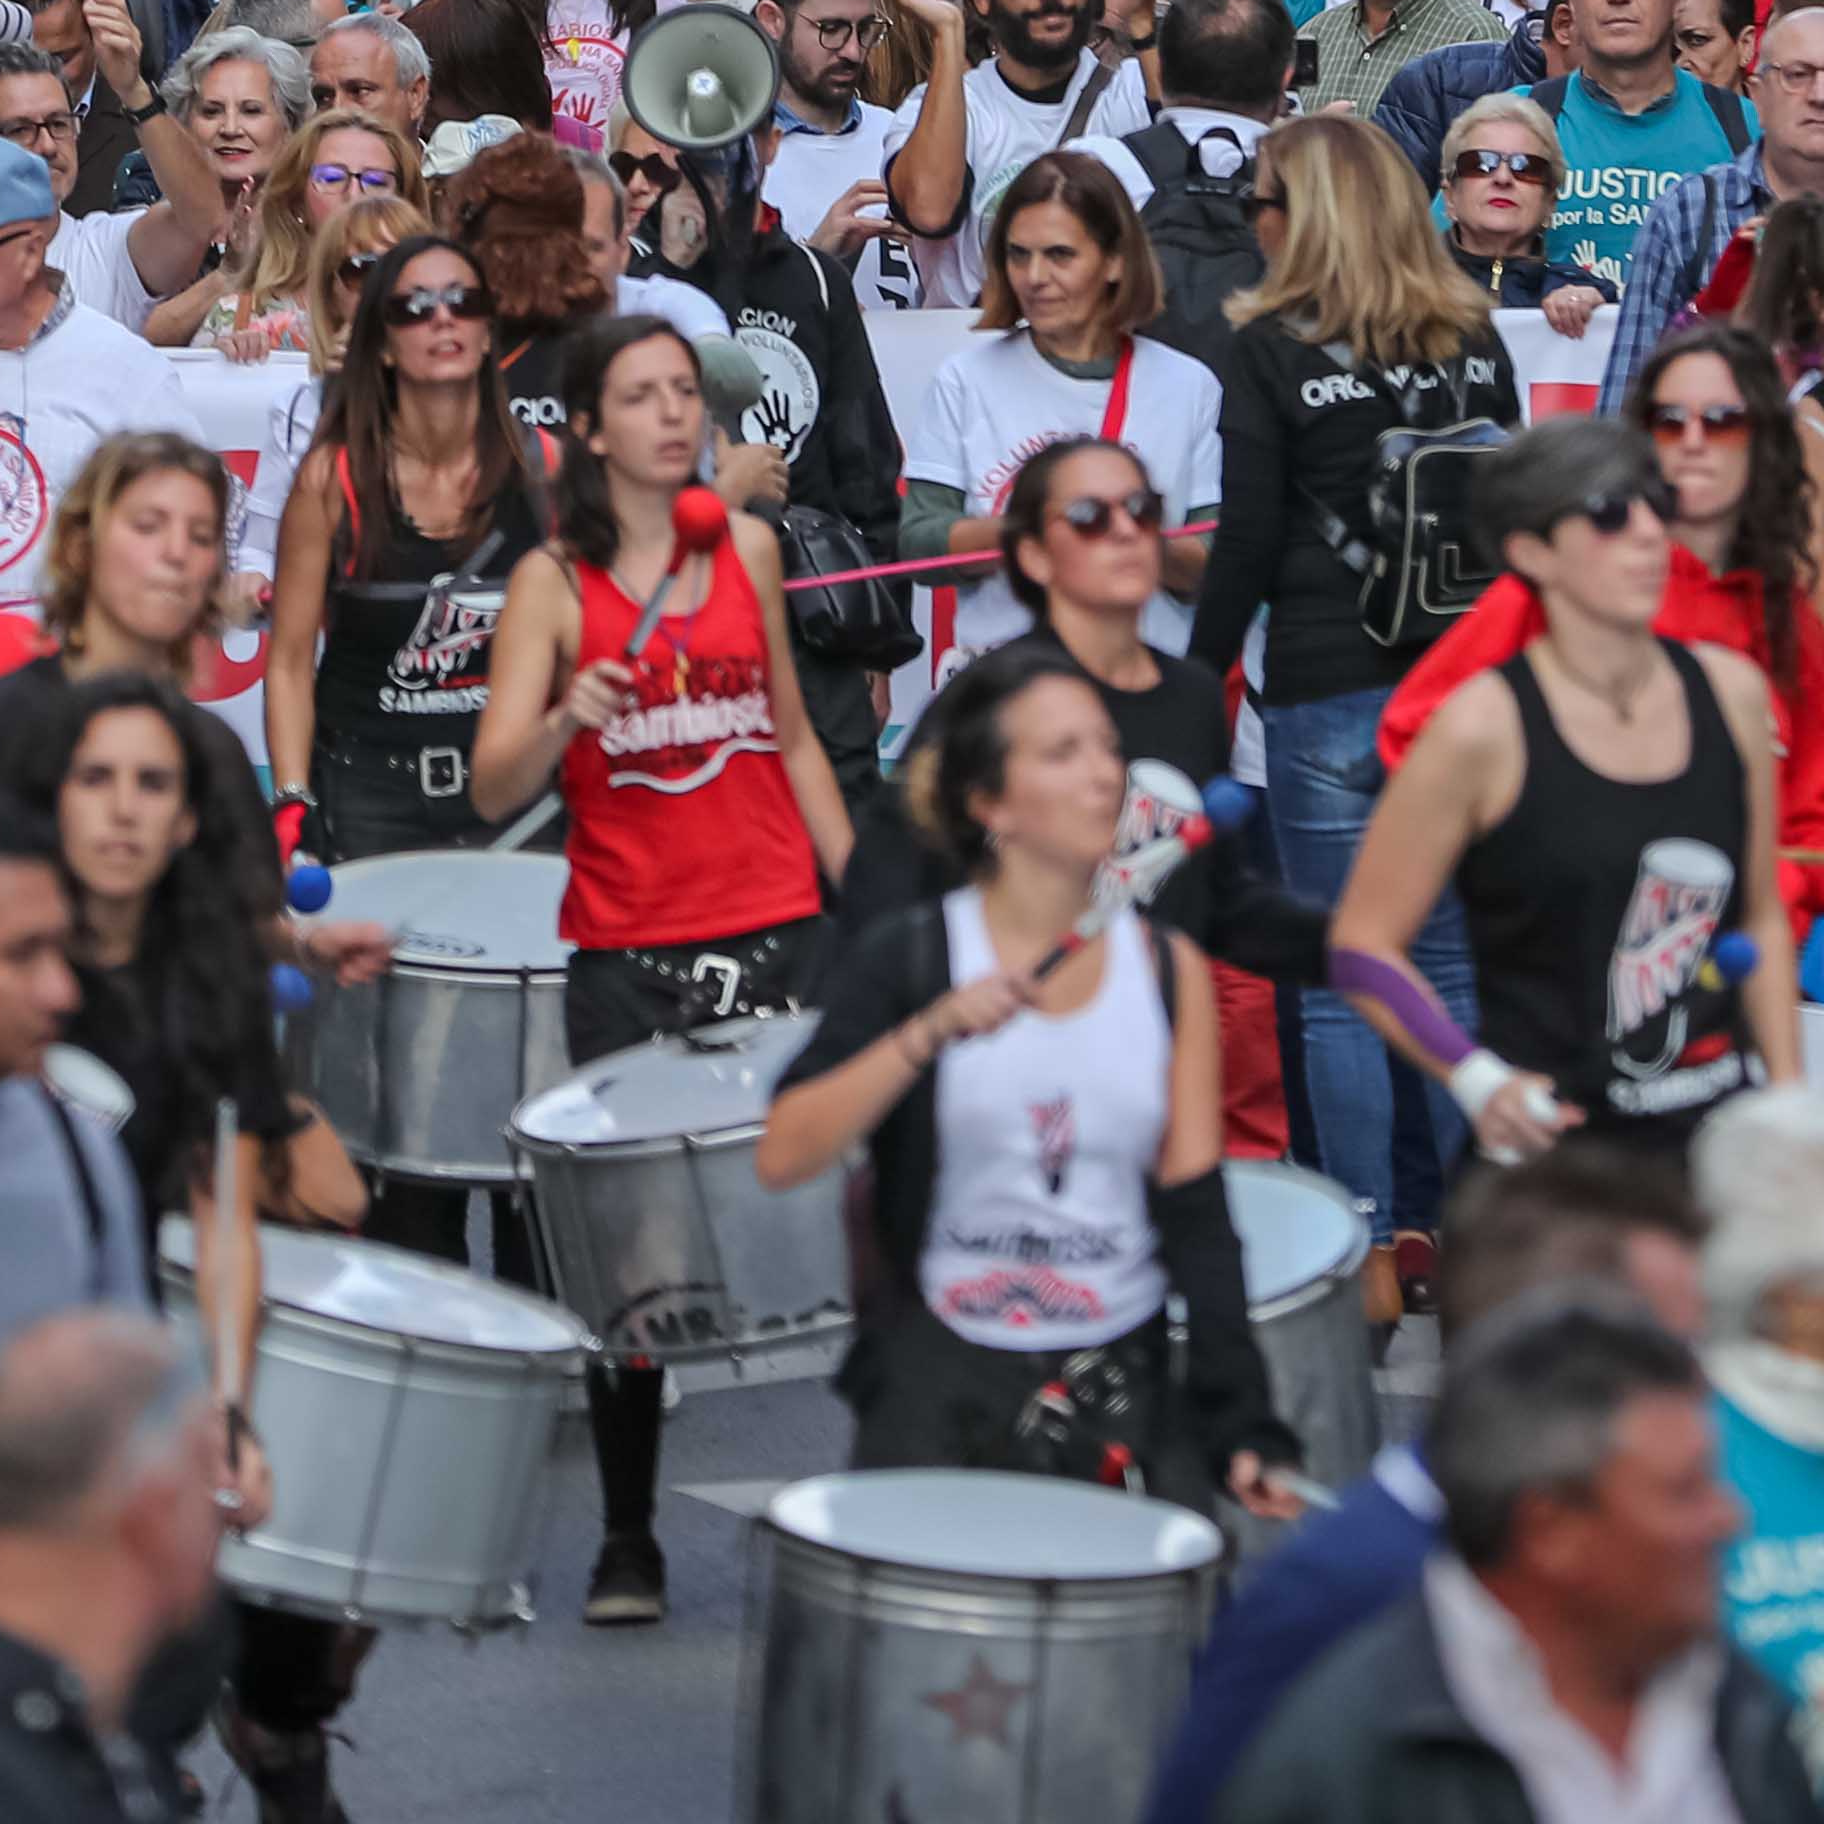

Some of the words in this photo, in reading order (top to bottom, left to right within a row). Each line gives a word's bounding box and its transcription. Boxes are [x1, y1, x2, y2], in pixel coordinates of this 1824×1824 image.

[1556, 166, 1683, 200] JUSTIC
[1550, 210, 1583, 229] por
[1586, 206, 1604, 225] la
[378, 685, 491, 714] SAMBIOS
